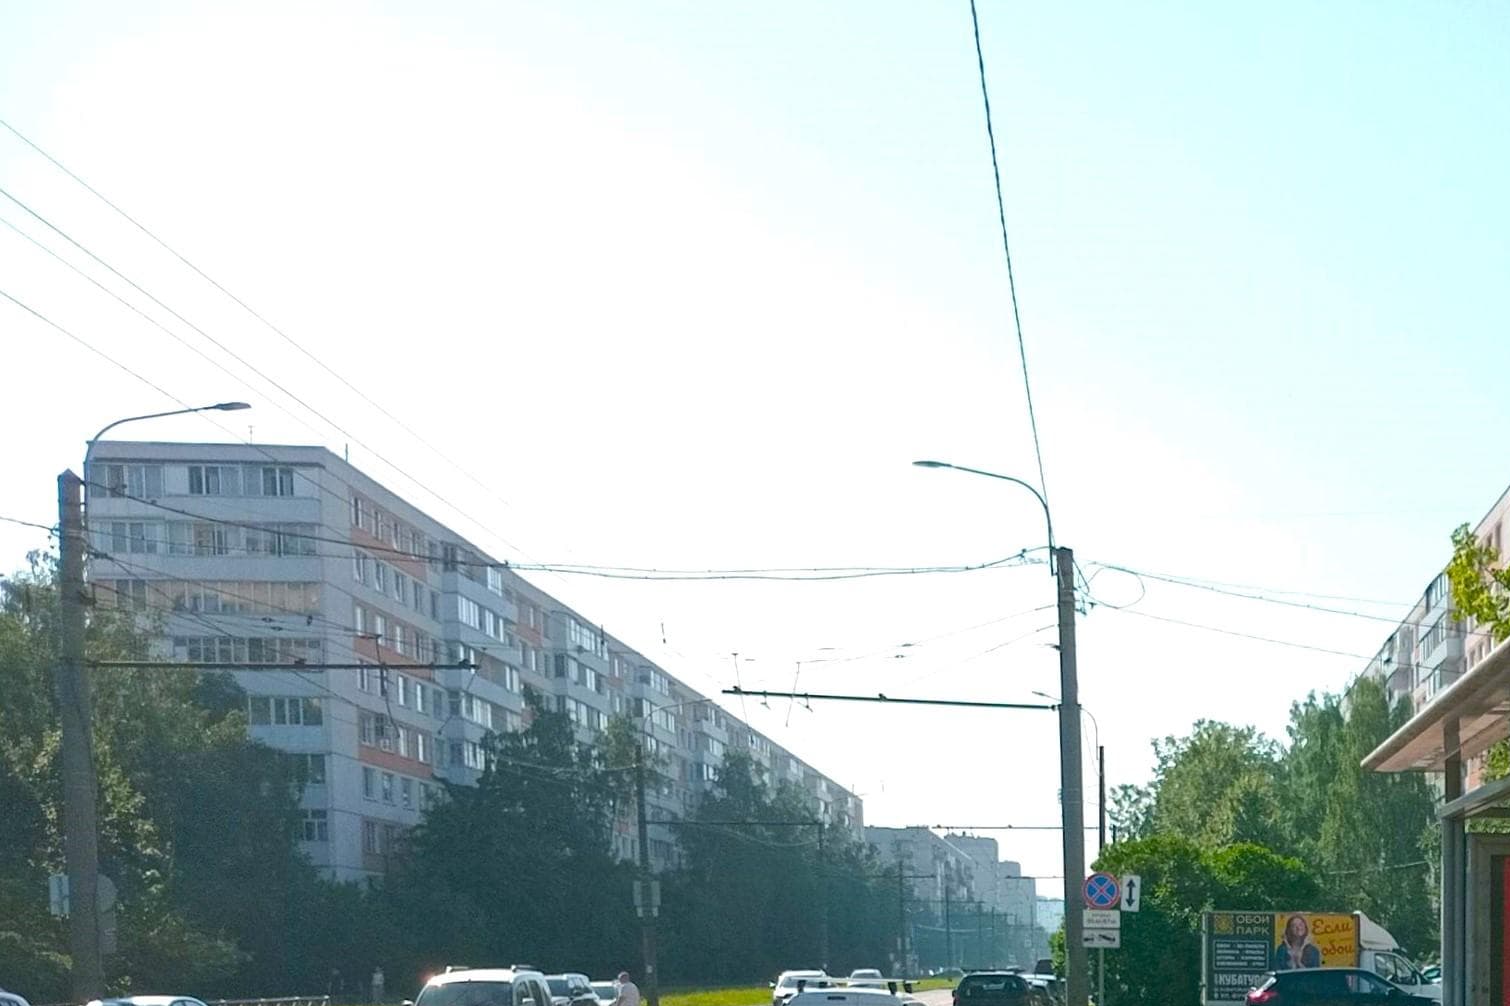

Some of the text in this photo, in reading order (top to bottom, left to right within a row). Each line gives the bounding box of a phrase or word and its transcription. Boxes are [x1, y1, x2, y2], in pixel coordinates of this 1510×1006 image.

[1236, 915, 1270, 924] ОБОИ
[1236, 927, 1270, 935] ПАРК
[1312, 919, 1353, 935] Если
